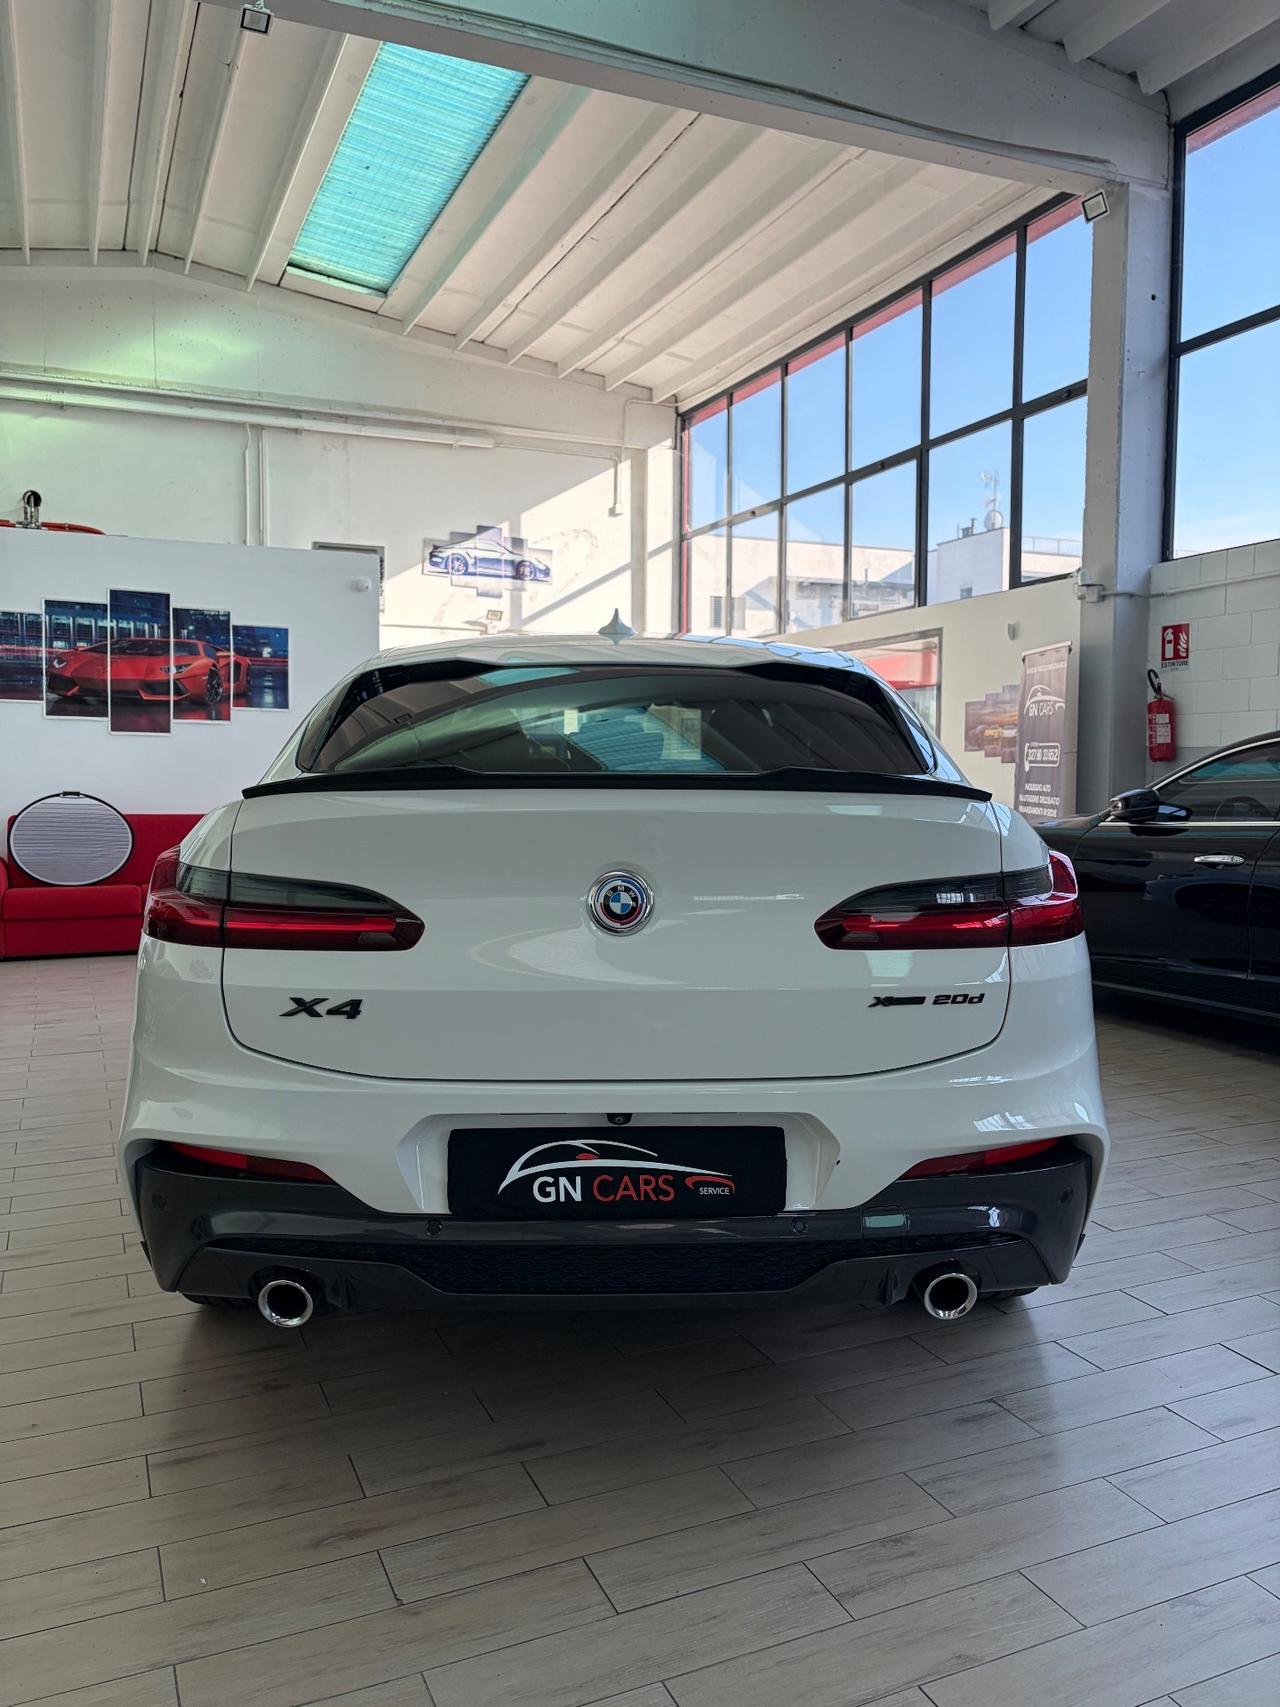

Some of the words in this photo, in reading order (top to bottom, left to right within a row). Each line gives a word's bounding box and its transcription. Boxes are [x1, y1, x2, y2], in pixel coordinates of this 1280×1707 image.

[1161, 660, 1188, 669] ESTINTORE
[1038, 701, 1054, 716] CARS
[932, 993, 985, 1005] 20d
[279, 997, 363, 1019] X4
[532, 1175, 582, 1203] GN
[592, 1174, 675, 1202] CARS
[699, 1187, 730, 1195] SERVICE
